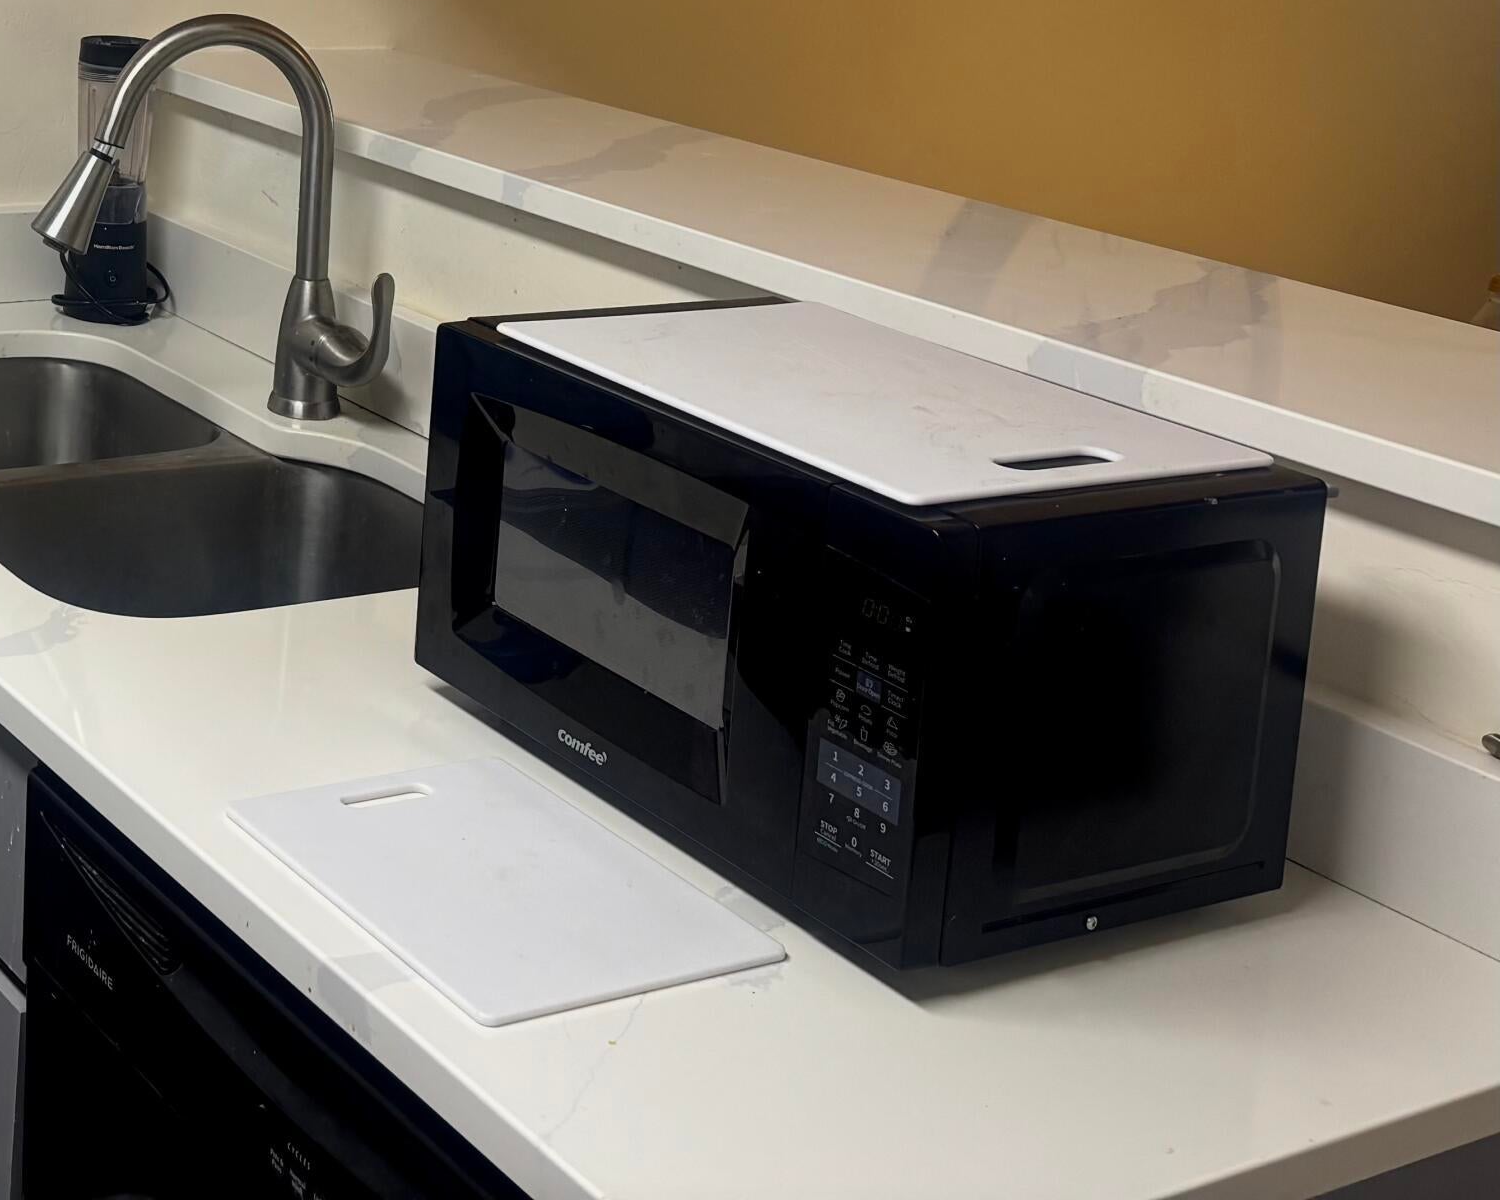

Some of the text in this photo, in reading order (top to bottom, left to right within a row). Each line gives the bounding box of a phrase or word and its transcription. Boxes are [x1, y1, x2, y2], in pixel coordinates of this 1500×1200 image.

[832, 751, 838, 763] 1
[830, 771, 836, 783] 4
[858, 764, 864, 777] 2
[884, 778, 891, 791] 3
[828, 792, 835, 804] 7
[856, 785, 862, 798] 5
[853, 807, 860, 819] 8
[882, 801, 889, 813] 6
[819, 818, 838, 835] STOP
[880, 821, 886, 834] 9
[869, 848, 892, 868] START
[66, 933, 114, 991] FRIGIDAIRE
